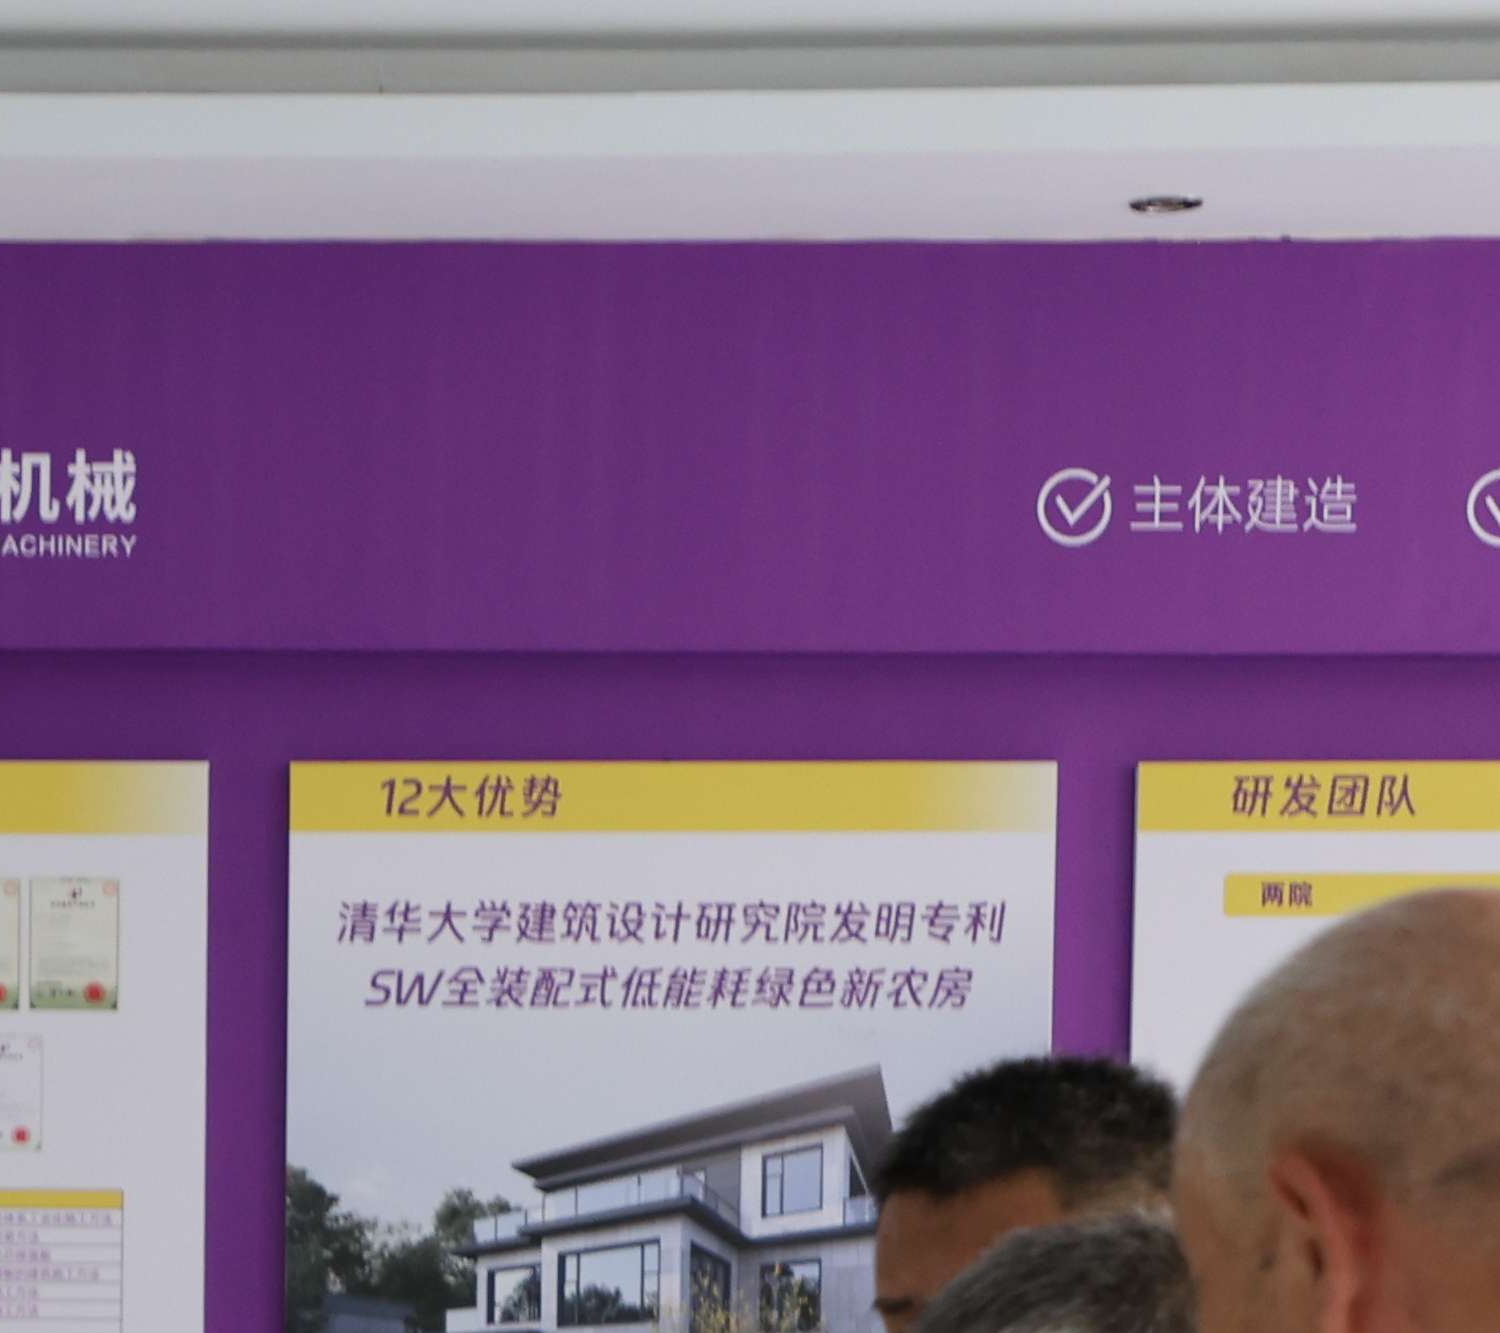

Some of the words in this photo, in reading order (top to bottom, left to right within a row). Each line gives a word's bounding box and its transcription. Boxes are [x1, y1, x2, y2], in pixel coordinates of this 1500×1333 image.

[1129, 475, 1359, 535] 主体建造
[380, 775, 563, 818] 12大优势
[1231, 774, 1417, 818] 研发团队
[1260, 882, 1313, 907] 两院
[336, 900, 1008, 945] 清华大学建筑设计研究院发明专利
[364, 968, 974, 1011] SW全装配式低能耗绿色新农房
